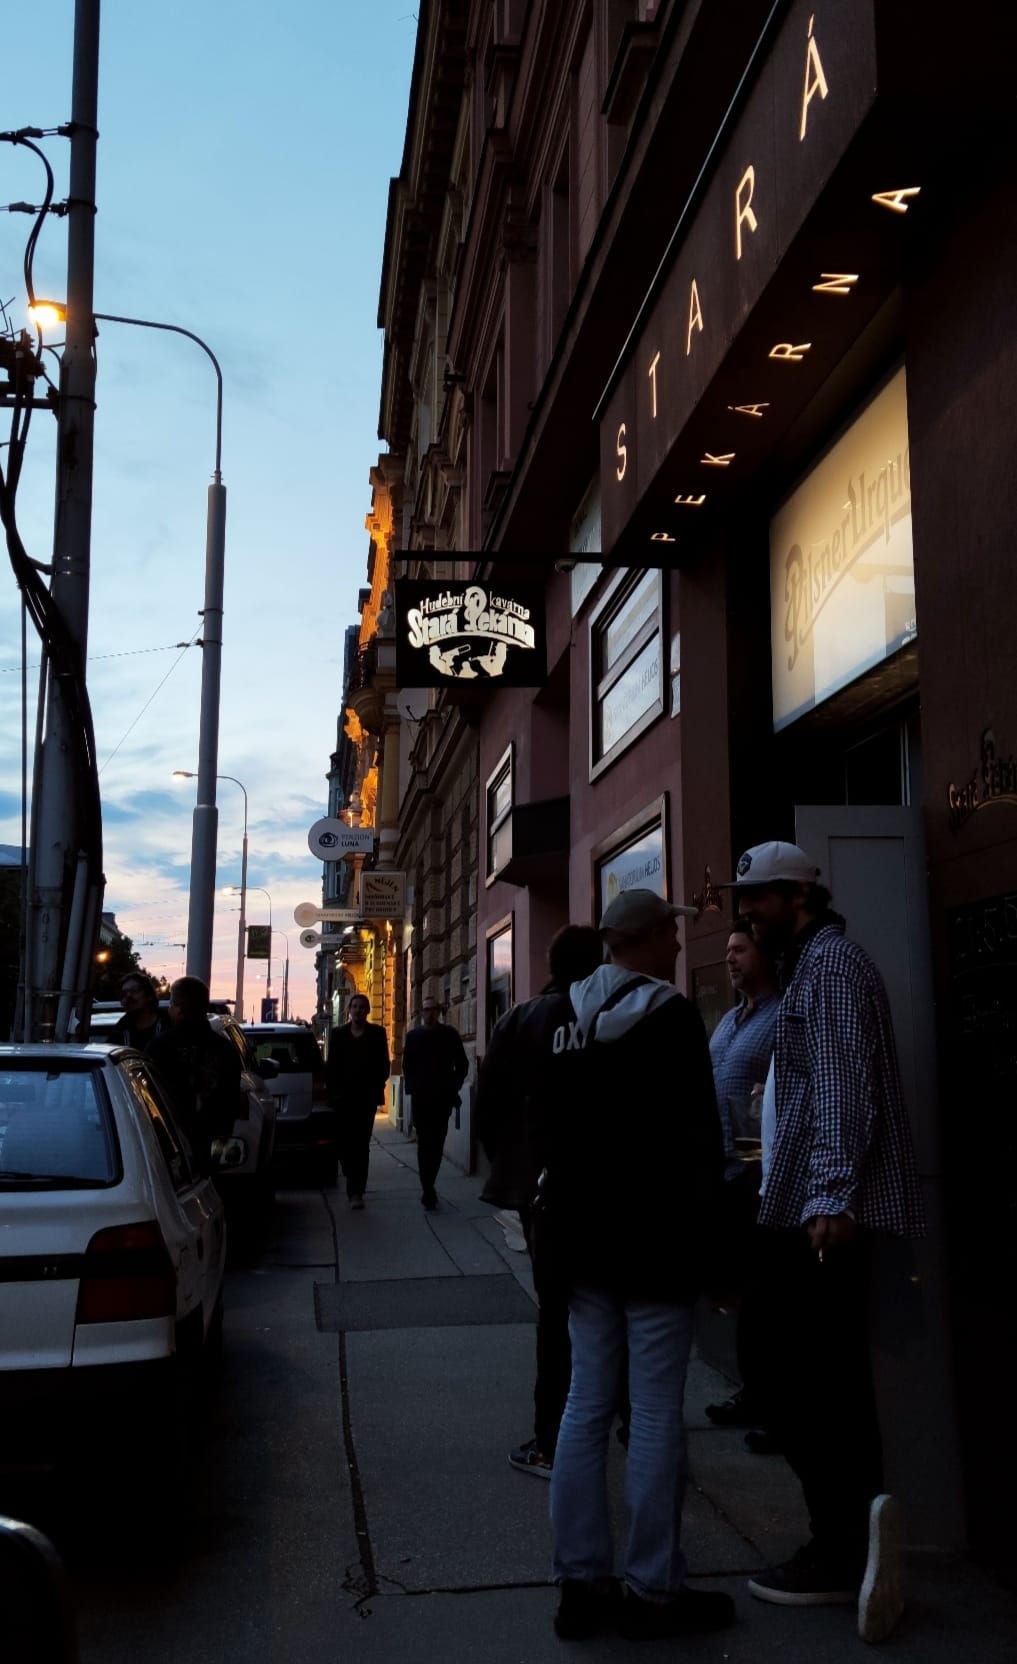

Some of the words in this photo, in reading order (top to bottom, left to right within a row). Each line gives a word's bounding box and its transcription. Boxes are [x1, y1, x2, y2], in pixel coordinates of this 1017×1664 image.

[615, 14, 829, 482] STARÁ
[650, 186, 922, 542] PEKÁRNA
[407, 607, 460, 648] Stará
[463, 586, 536, 649] Pekárna
[420, 590, 465, 616] Hudební
[489, 590, 530, 620] kavárna
[785, 513, 849, 672] Pilsner
[644, 855, 661, 878] HELIOS
